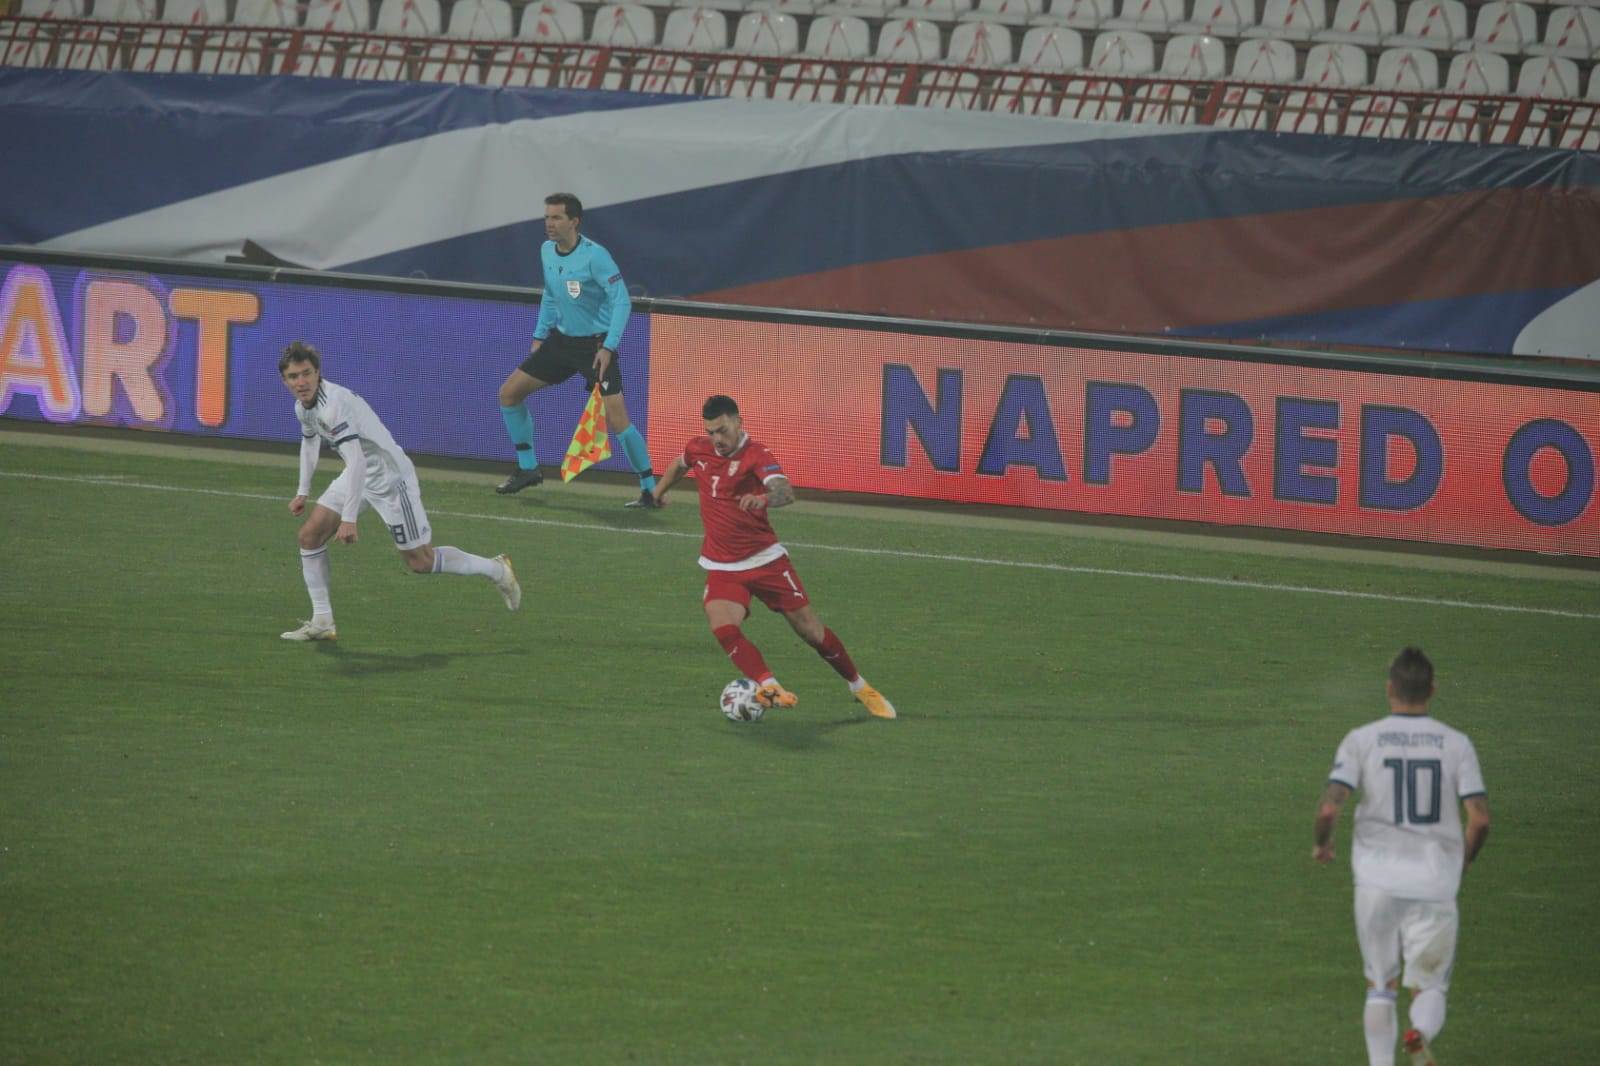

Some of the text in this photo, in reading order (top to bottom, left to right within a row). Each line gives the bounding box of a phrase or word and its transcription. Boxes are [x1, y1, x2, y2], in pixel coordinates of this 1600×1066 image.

[0, 266, 260, 426] ART
[711, 475, 720, 497] 7
[879, 362, 1595, 528] NAPRED O
[1383, 758, 1442, 825] 10
